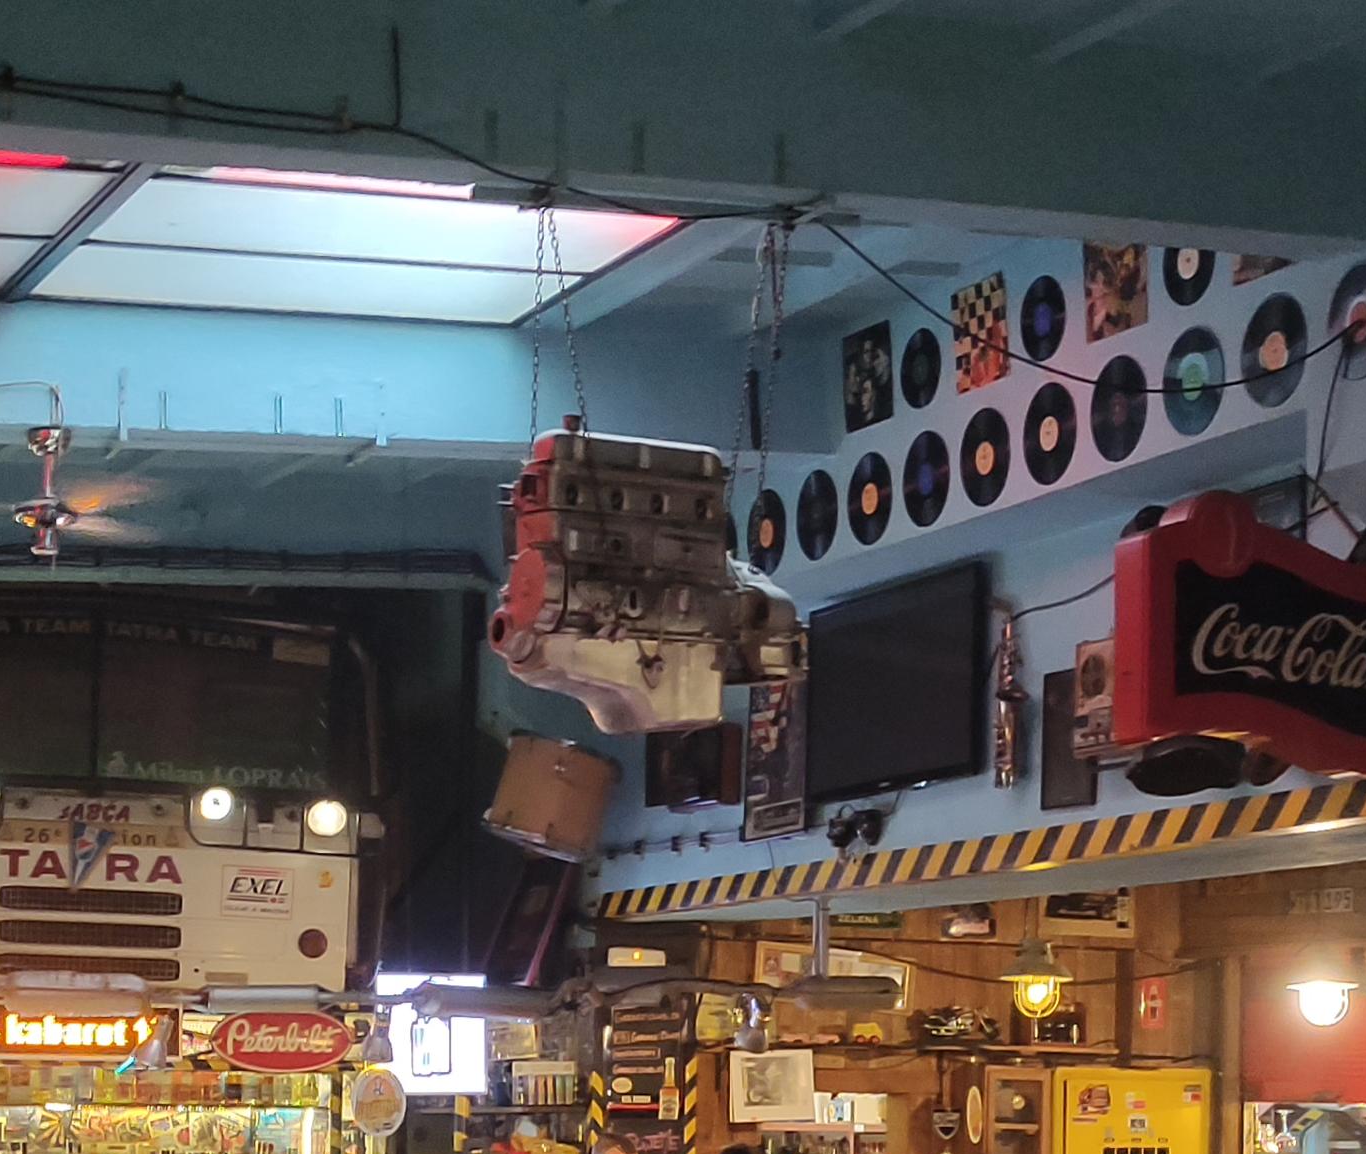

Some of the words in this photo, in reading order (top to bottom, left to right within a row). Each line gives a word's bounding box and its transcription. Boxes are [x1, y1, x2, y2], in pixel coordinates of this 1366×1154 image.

[22, 618, 92, 635] TEAM
[0, 848, 184, 884] TARA
[229, 876, 289, 896] EXEL
[227, 1018, 335, 1055] Peterbilt
